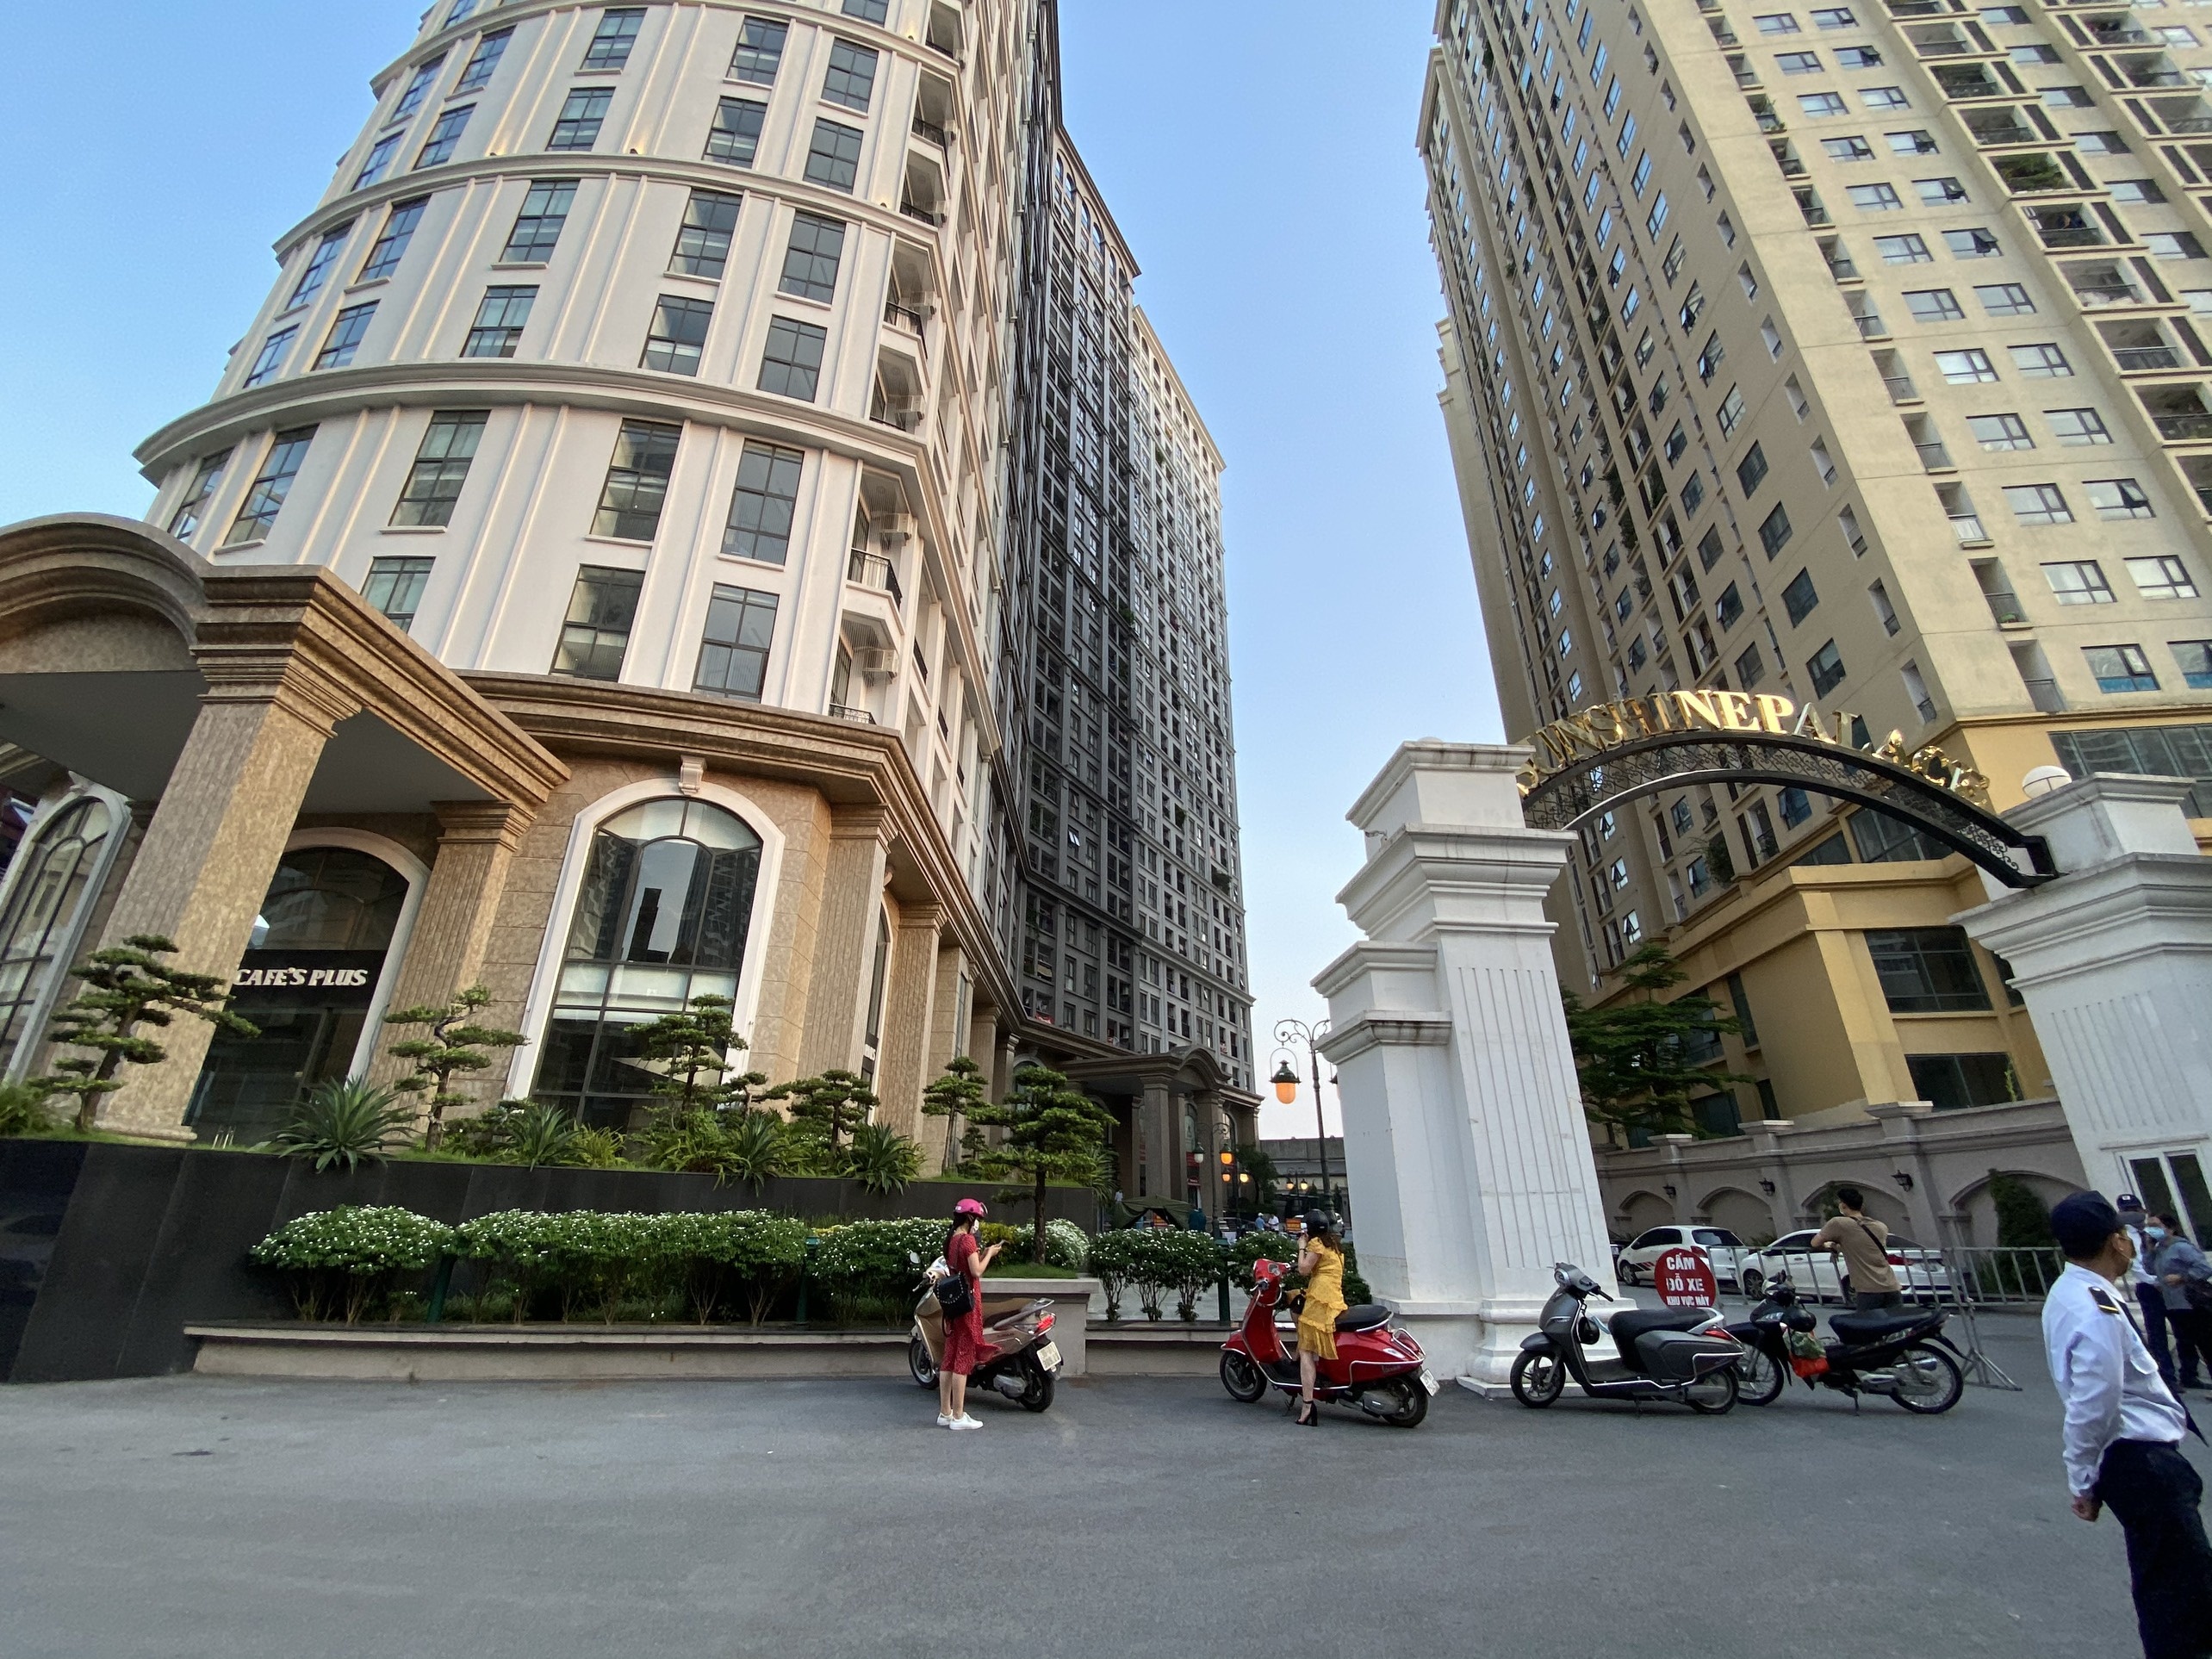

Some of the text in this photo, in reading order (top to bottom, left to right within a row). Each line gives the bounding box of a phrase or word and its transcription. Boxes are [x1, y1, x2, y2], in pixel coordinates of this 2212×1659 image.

[308, 969, 368, 986] PLUS
[1666, 1252, 1695, 1271] CẤM
[1686, 1277, 1705, 1291] XE
[1666, 1296, 1681, 1306] KHU
